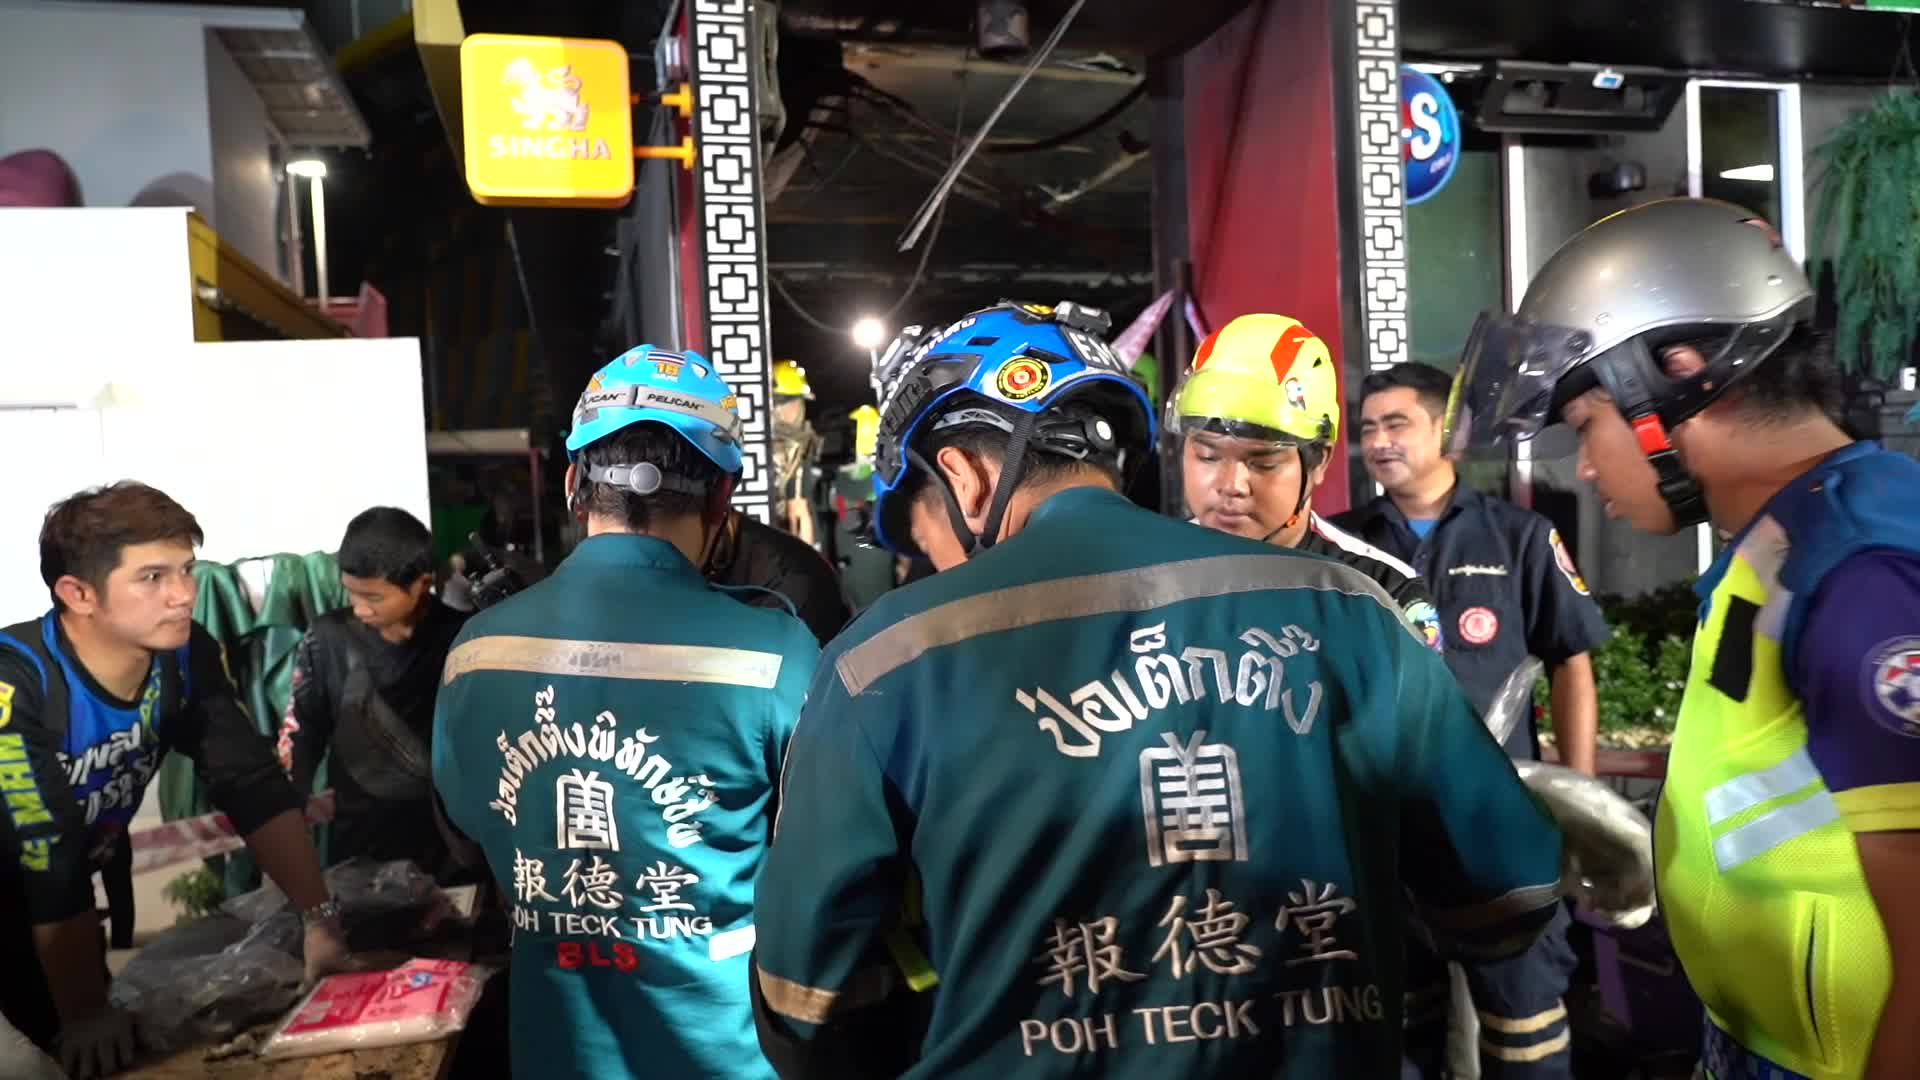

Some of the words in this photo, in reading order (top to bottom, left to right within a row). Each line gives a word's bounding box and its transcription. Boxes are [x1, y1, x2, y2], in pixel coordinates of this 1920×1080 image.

[490, 134, 612, 161] SINGHA
[647, 393, 700, 411] PELICAN
[512, 904, 540, 933] OH
[549, 911, 622, 939] TECK
[630, 915, 713, 941] TUNG
[1019, 1013, 1119, 1057] POH
[1133, 1000, 1261, 1045] TECK
[1273, 983, 1385, 1028] TUNG
